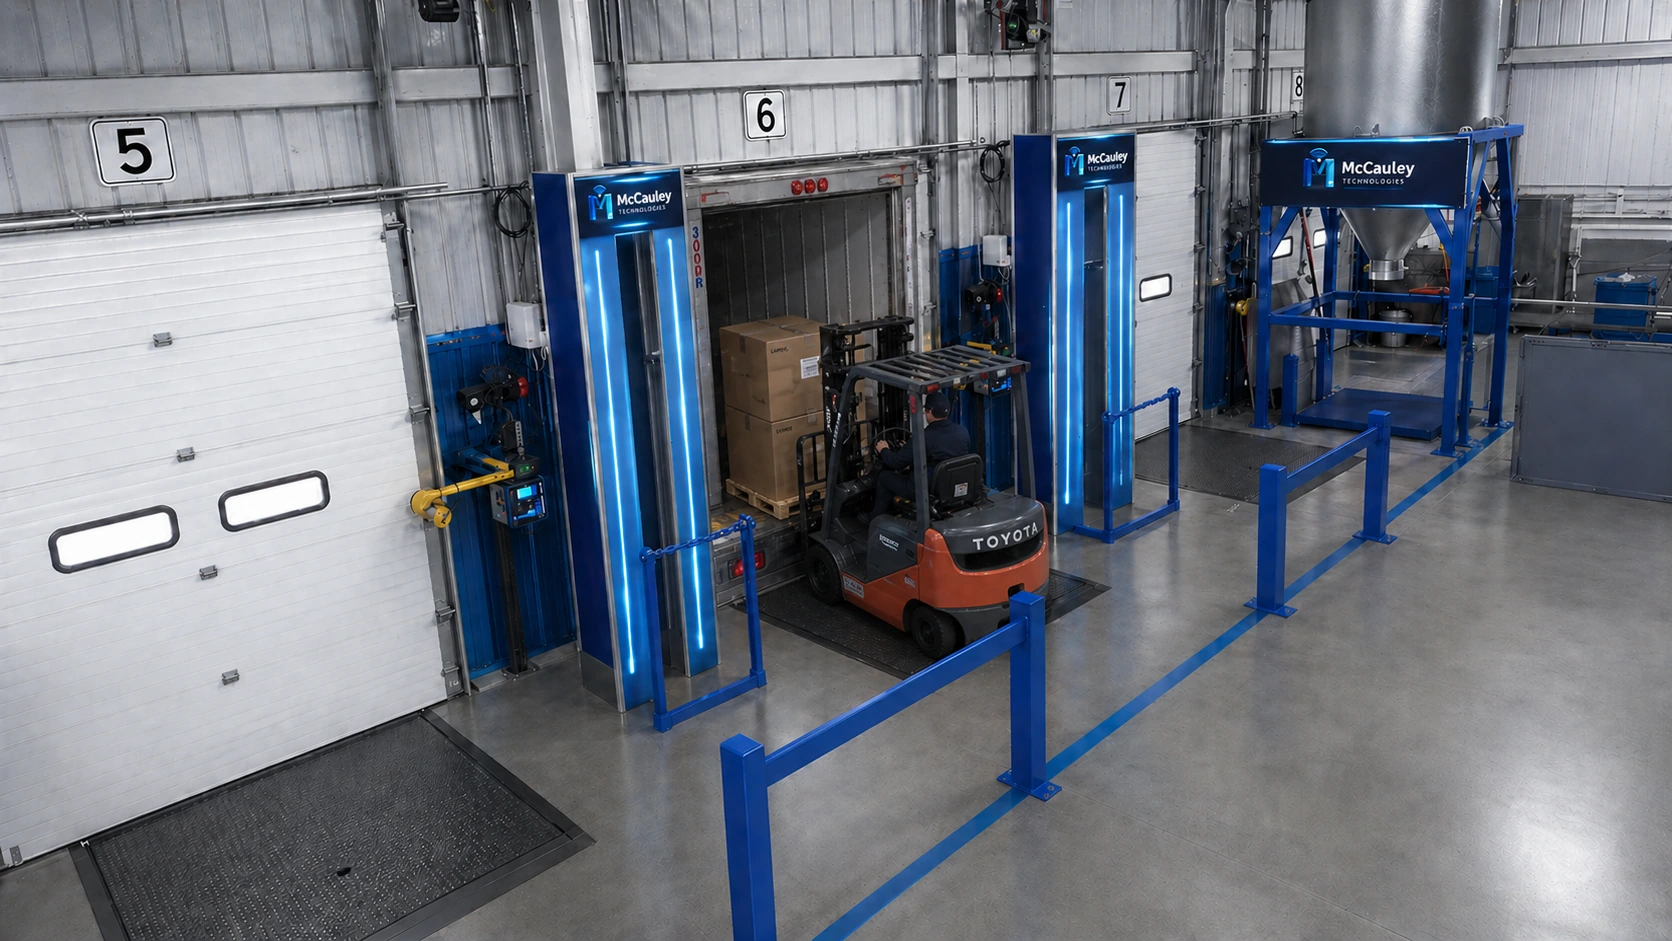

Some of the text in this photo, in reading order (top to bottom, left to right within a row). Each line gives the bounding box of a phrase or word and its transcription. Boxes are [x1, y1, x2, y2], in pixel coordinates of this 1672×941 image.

[1114, 81, 1126, 108] 7
[1295, 75, 1303, 97] 8
[757, 97, 775, 132] 6
[117, 127, 152, 175] 5
[1087, 151, 1129, 165] McCauley
[1341, 161, 1415, 178] McCauley
[617, 190, 672, 207] McCauley
[972, 522, 1039, 551] TOYOTA
